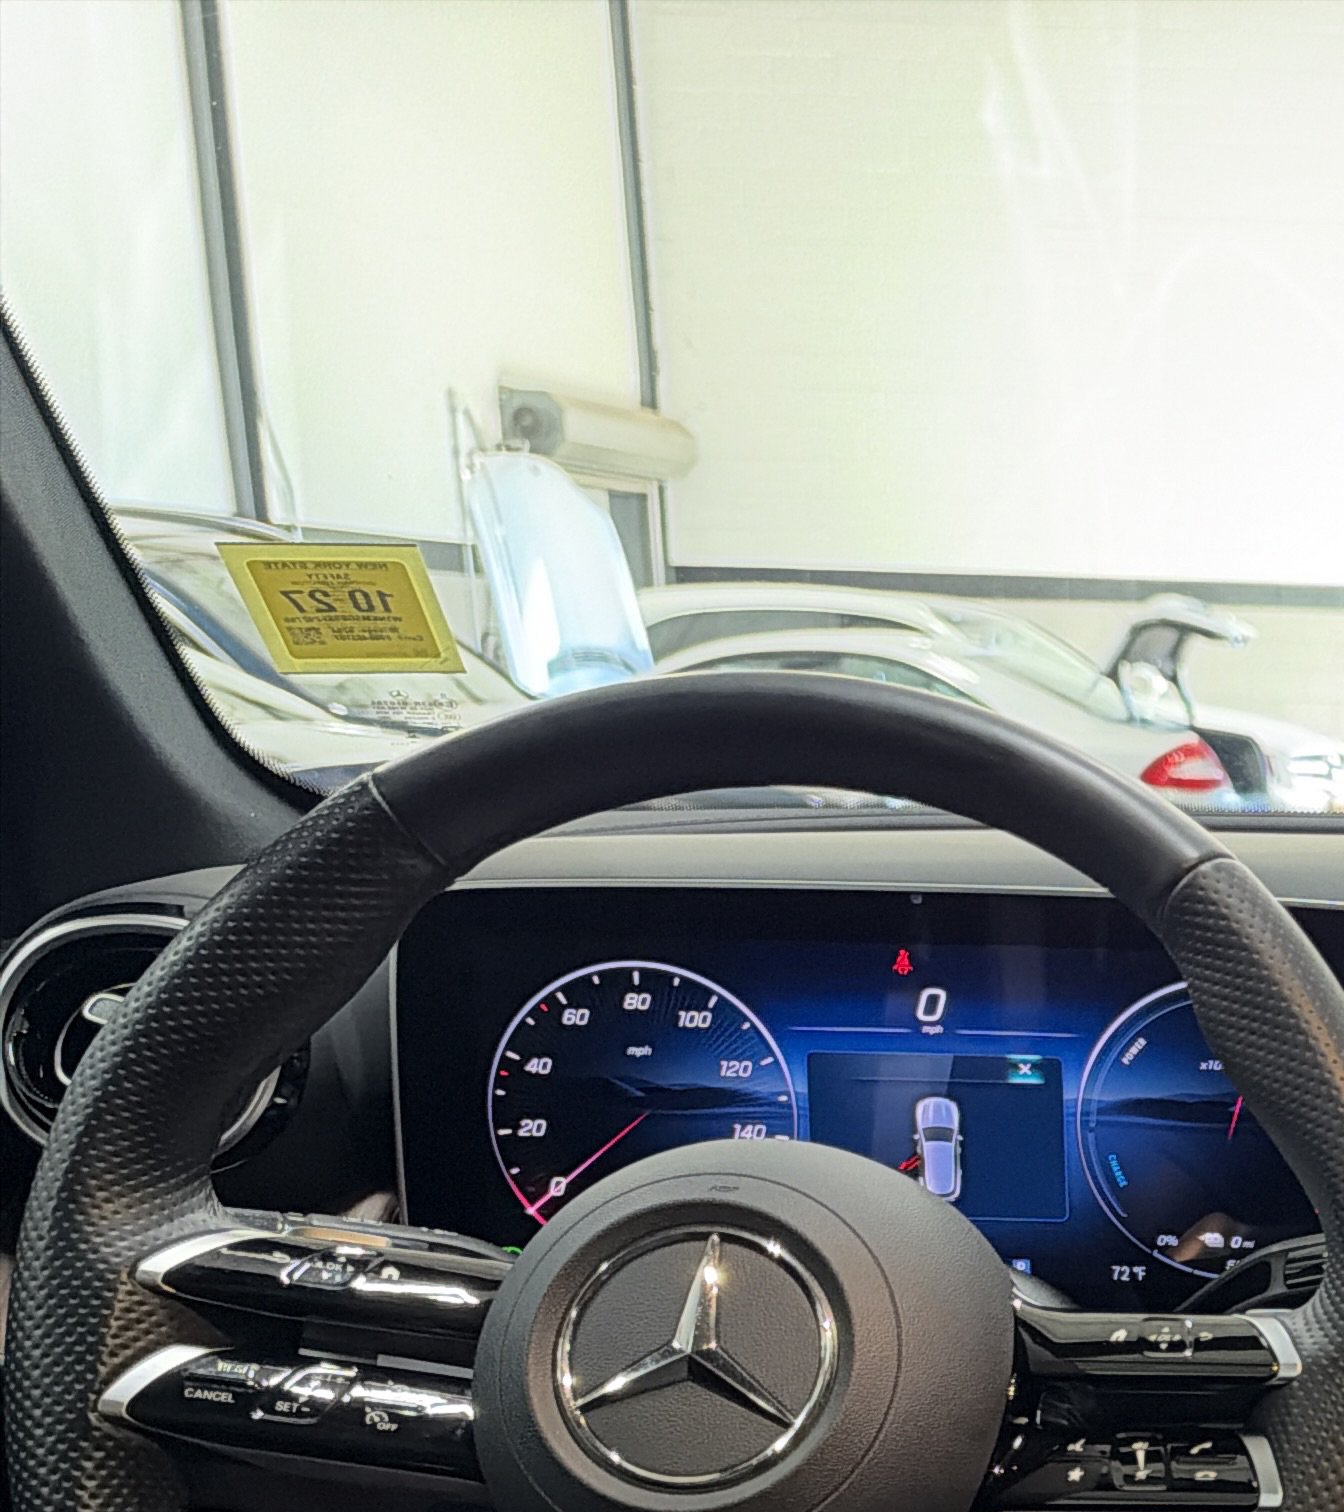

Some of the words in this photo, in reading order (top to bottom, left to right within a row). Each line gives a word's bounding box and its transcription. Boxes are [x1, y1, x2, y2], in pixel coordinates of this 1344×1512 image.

[623, 993, 651, 1010] 80
[916, 987, 947, 1021] 0
[562, 1008, 590, 1026] 60
[677, 1010, 712, 1028] 100
[921, 1025, 944, 1035] mph
[626, 1045, 652, 1057] mph
[1120, 1037, 1148, 1066] POWER
[524, 1057, 552, 1075] 40
[719, 1060, 752, 1078] 120
[517, 1119, 547, 1137] 20
[732, 1123, 767, 1140] 140
[1108, 1154, 1129, 1188] CHARGE
[550, 1176, 567, 1197] 0
[1156, 1234, 1179, 1247] 0%
[1230, 1236, 1243, 1249] 0
[1111, 1265, 1131, 1281] 72
[184, 1387, 236, 1404] CANCEL
[274, 1401, 300, 1413] SET
